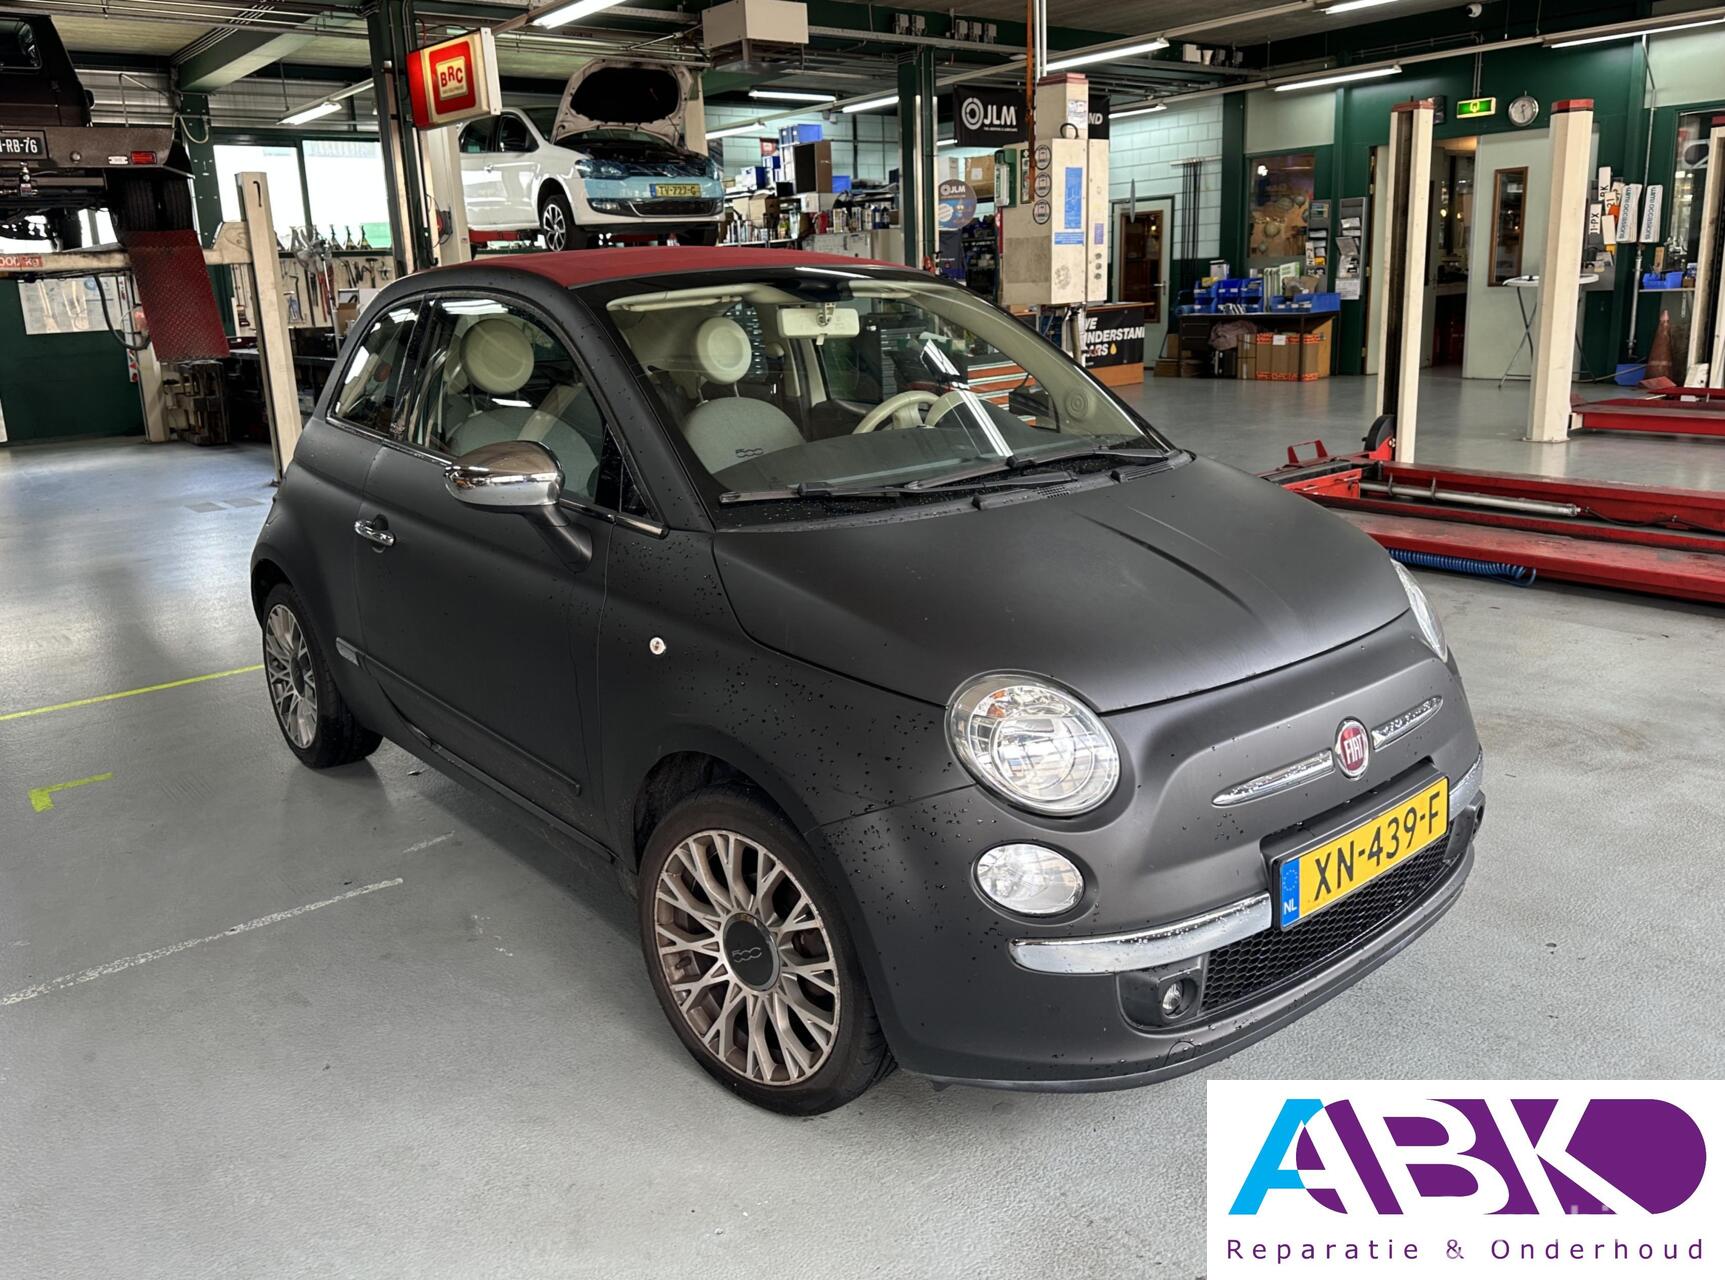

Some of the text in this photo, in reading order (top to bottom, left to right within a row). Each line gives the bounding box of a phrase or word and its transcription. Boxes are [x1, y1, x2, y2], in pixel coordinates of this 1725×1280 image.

[440, 65, 464, 88] BRC
[983, 104, 1017, 126] JLM
[951, 185, 966, 193] JLM
[1343, 734, 1364, 765] FIAT
[1314, 791, 1440, 901] XN-439-F
[1283, 898, 1297, 915] NL
